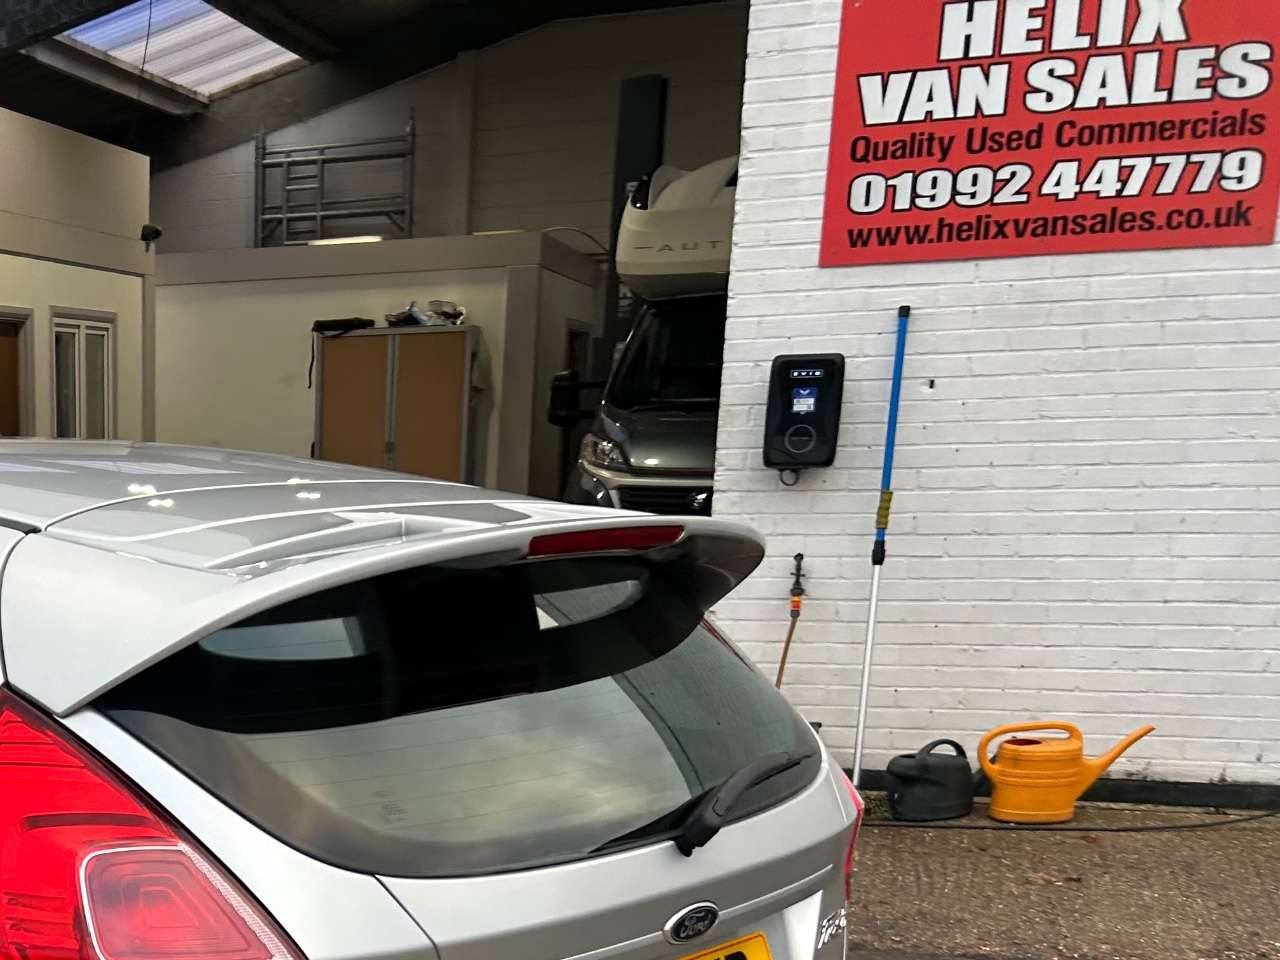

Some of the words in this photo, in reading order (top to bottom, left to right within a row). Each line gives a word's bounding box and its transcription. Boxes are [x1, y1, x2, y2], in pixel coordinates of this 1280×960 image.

[938, 0, 1190, 61] HELIX
[858, 63, 1009, 127] VAN
[1023, 41, 1273, 113] SALES
[850, 132, 955, 163] Quality
[966, 122, 1044, 154] Used
[1056, 108, 1266, 148] Commercials
[848, 162, 1033, 215] 01992
[1039, 148, 1265, 202] 447779
[848, 201, 1255, 248] www.helixvansales.co.uk
